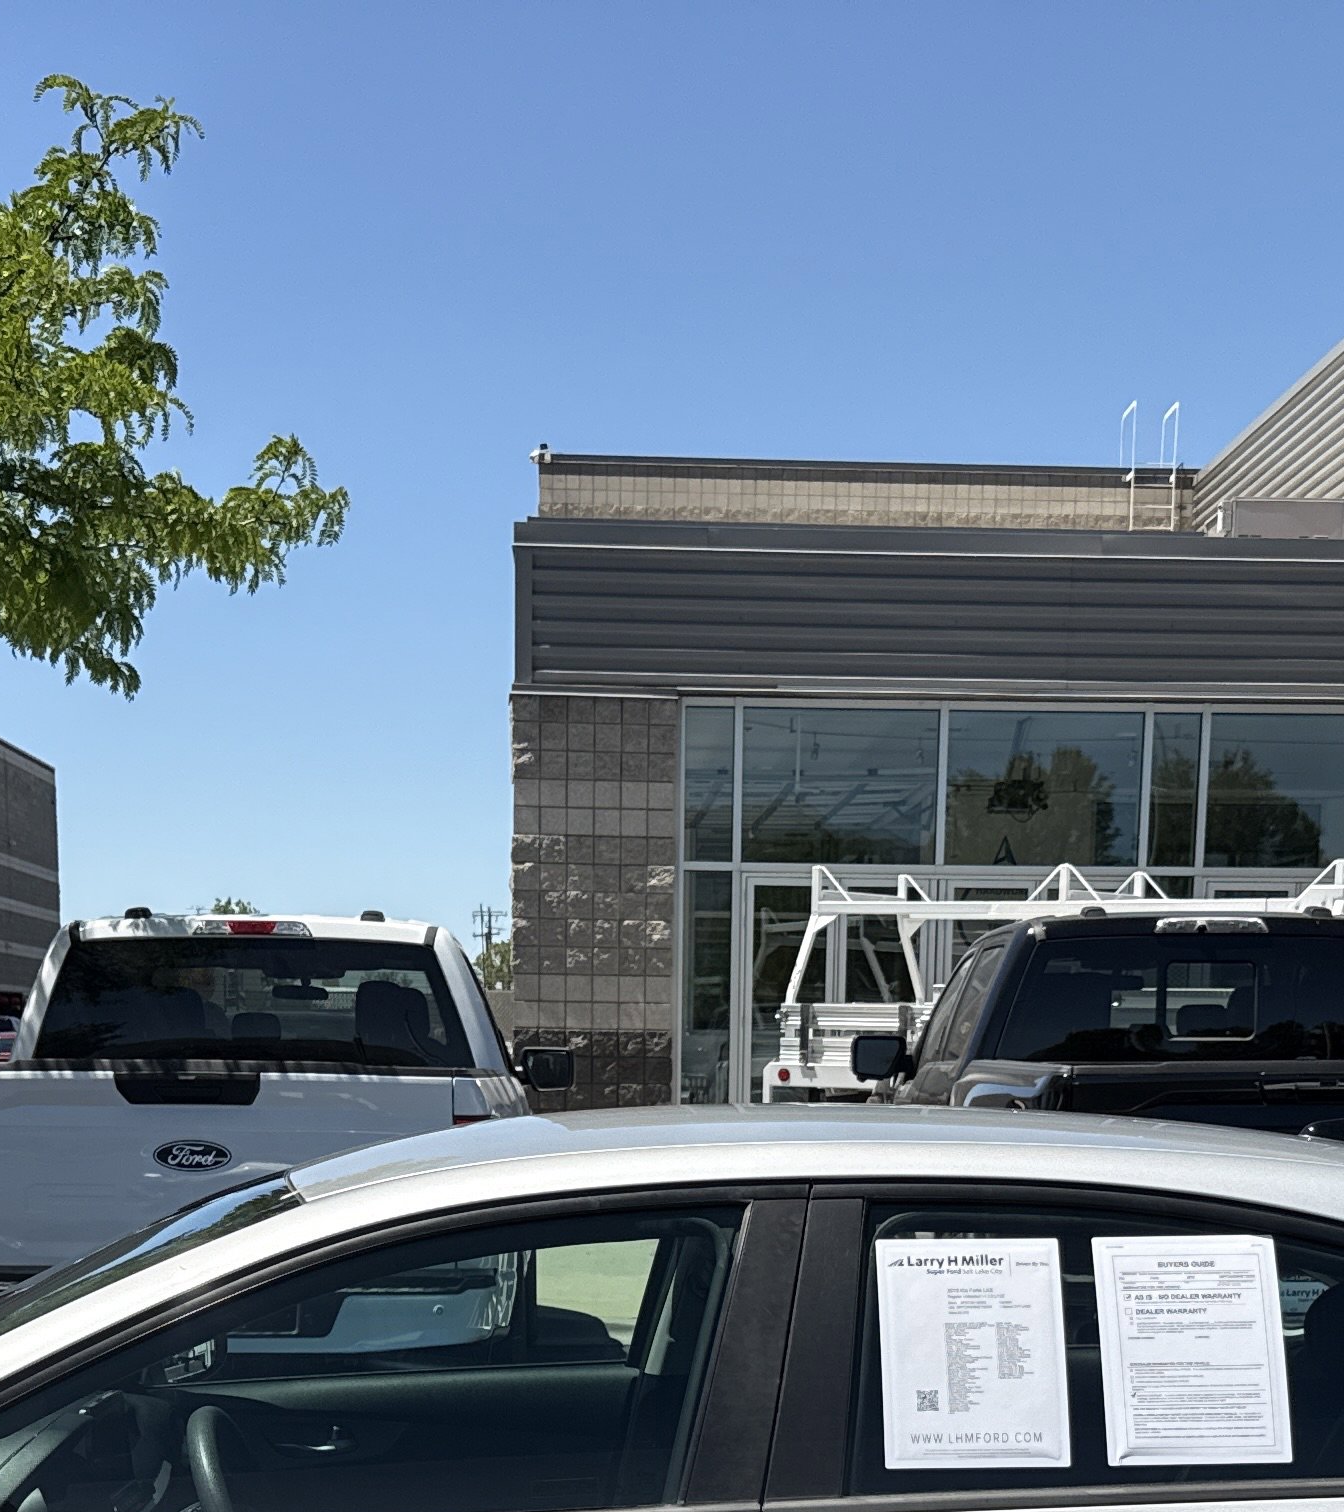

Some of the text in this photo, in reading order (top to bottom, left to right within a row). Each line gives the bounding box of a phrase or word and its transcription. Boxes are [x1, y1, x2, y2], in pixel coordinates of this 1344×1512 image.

[167, 1145, 218, 1166] Ford
[906, 1254, 1005, 1269] Larry H Miller
[926, 1268, 945, 1276] Super
[1286, 1288, 1311, 1297] Larry
